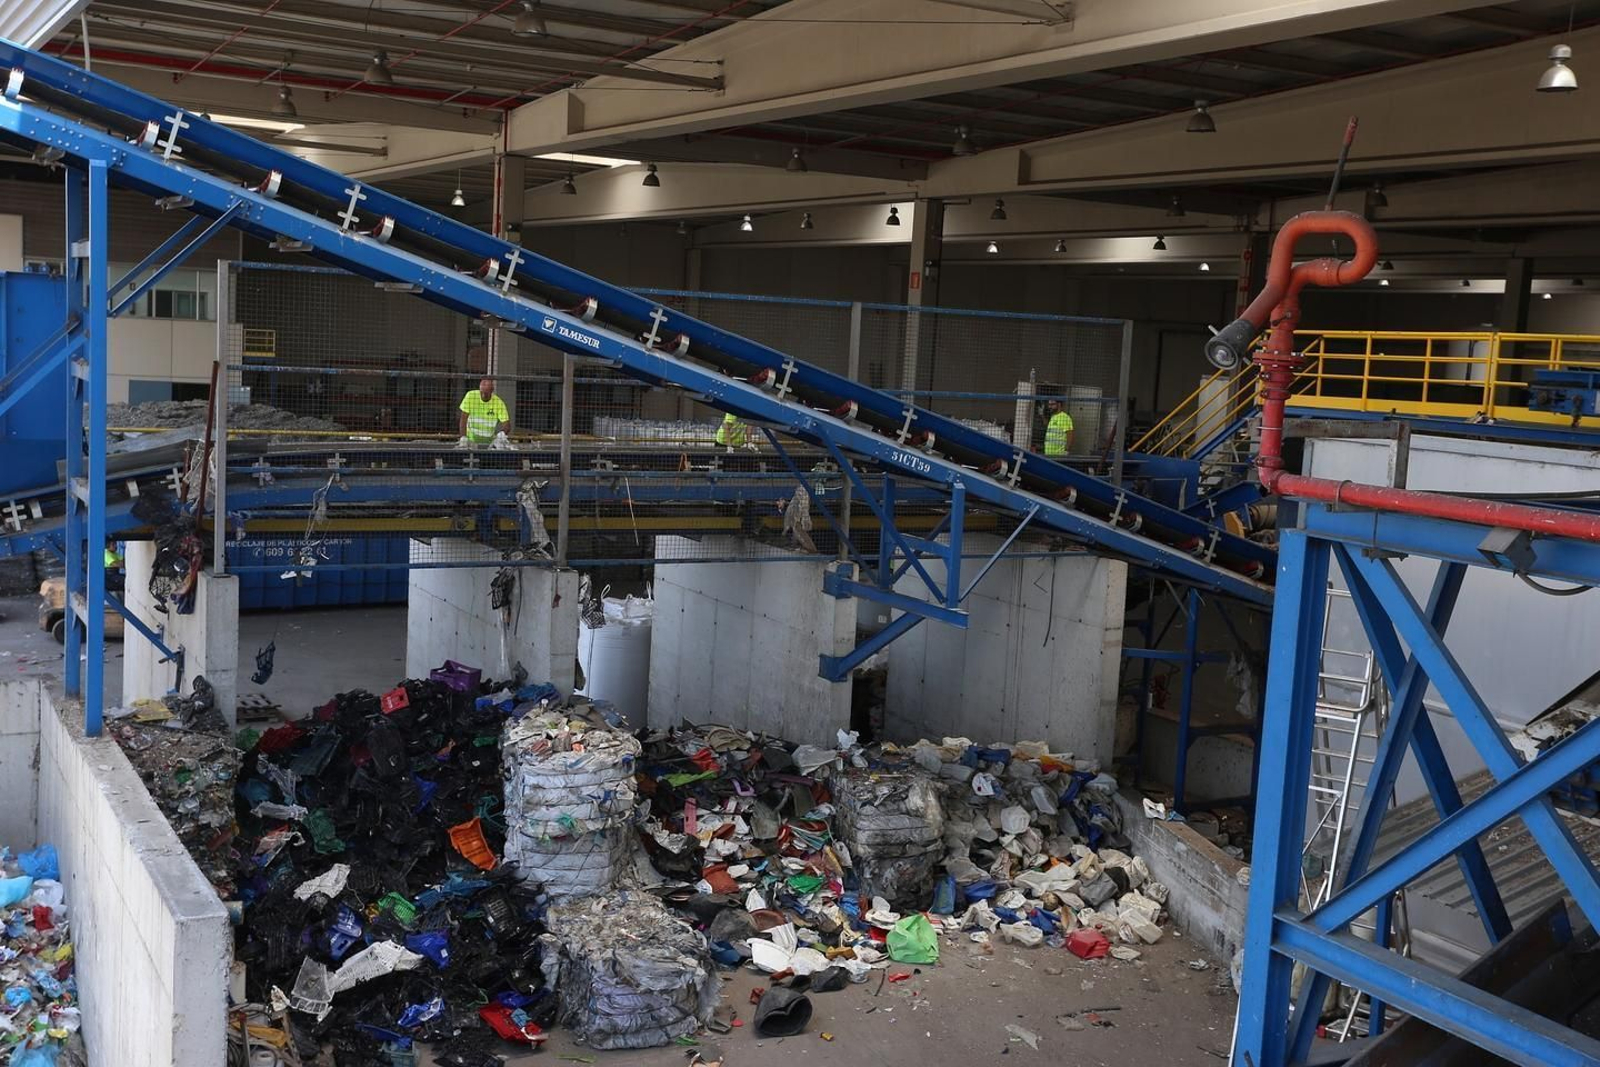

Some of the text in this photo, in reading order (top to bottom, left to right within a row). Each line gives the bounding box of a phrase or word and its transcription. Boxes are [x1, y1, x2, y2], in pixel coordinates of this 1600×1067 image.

[559, 326, 600, 349] TAMESUR
[892, 451, 931, 473] 51CT59
[225, 540, 265, 548] RECCLAJE
[266, 547, 284, 557] 609
